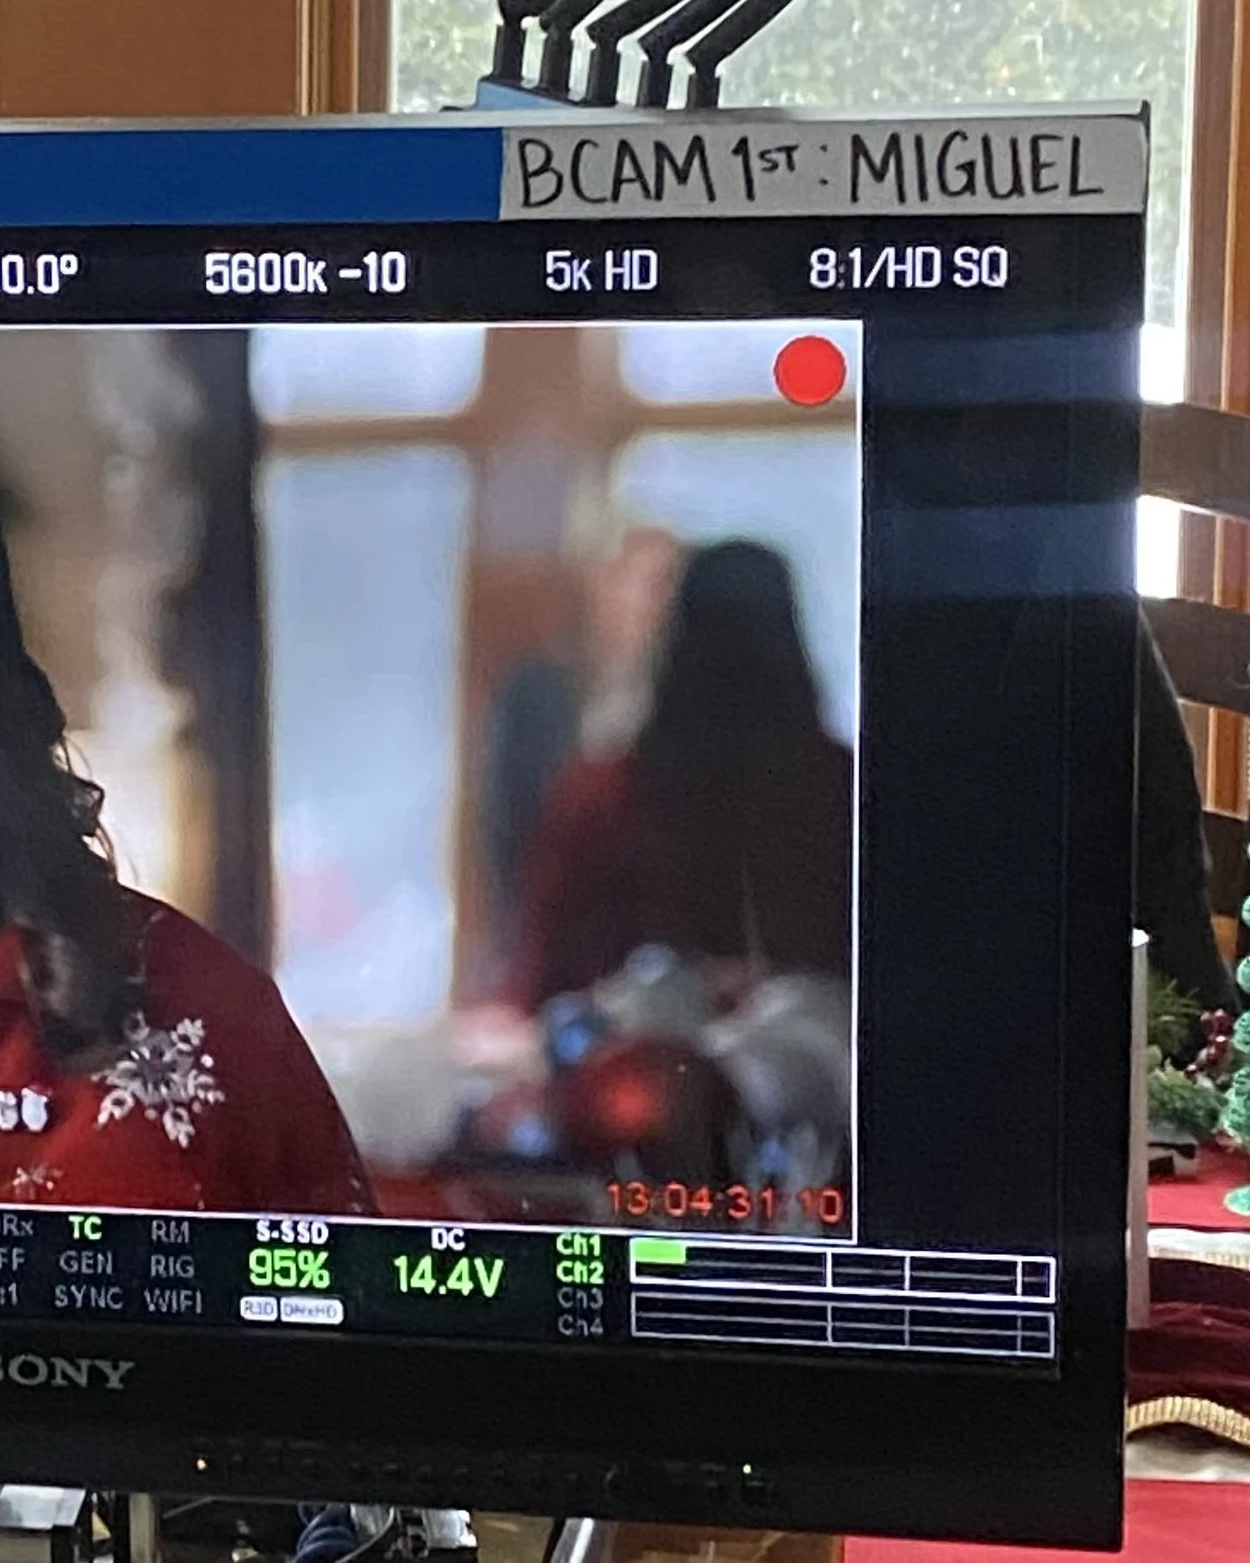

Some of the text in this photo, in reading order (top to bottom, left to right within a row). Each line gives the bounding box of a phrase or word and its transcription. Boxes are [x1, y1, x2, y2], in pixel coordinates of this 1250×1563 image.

[517, 130, 712, 208] BCAM
[850, 128, 1105, 205] MIGUEL
[337, 250, 407, 294] -10
[603, 249, 659, 292] HD
[808, 247, 1010, 289] 8:1/HD SQ
[68, 1215, 103, 1241] TC
[151, 1219, 190, 1244] RM
[430, 1228, 468, 1252] DC
[555, 1232, 603, 1258] Ch1
[58, 1249, 114, 1276] GEN
[150, 1253, 196, 1280] RIG
[248, 1247, 332, 1290] 95%
[555, 1258, 605, 1285] Ch2
[393, 1254, 506, 1299] 14.4V
[53, 1283, 125, 1312] SYNC
[144, 1289, 205, 1317] WIFI
[557, 1285, 604, 1310] Ch3
[558, 1310, 605, 1337] Ch4
